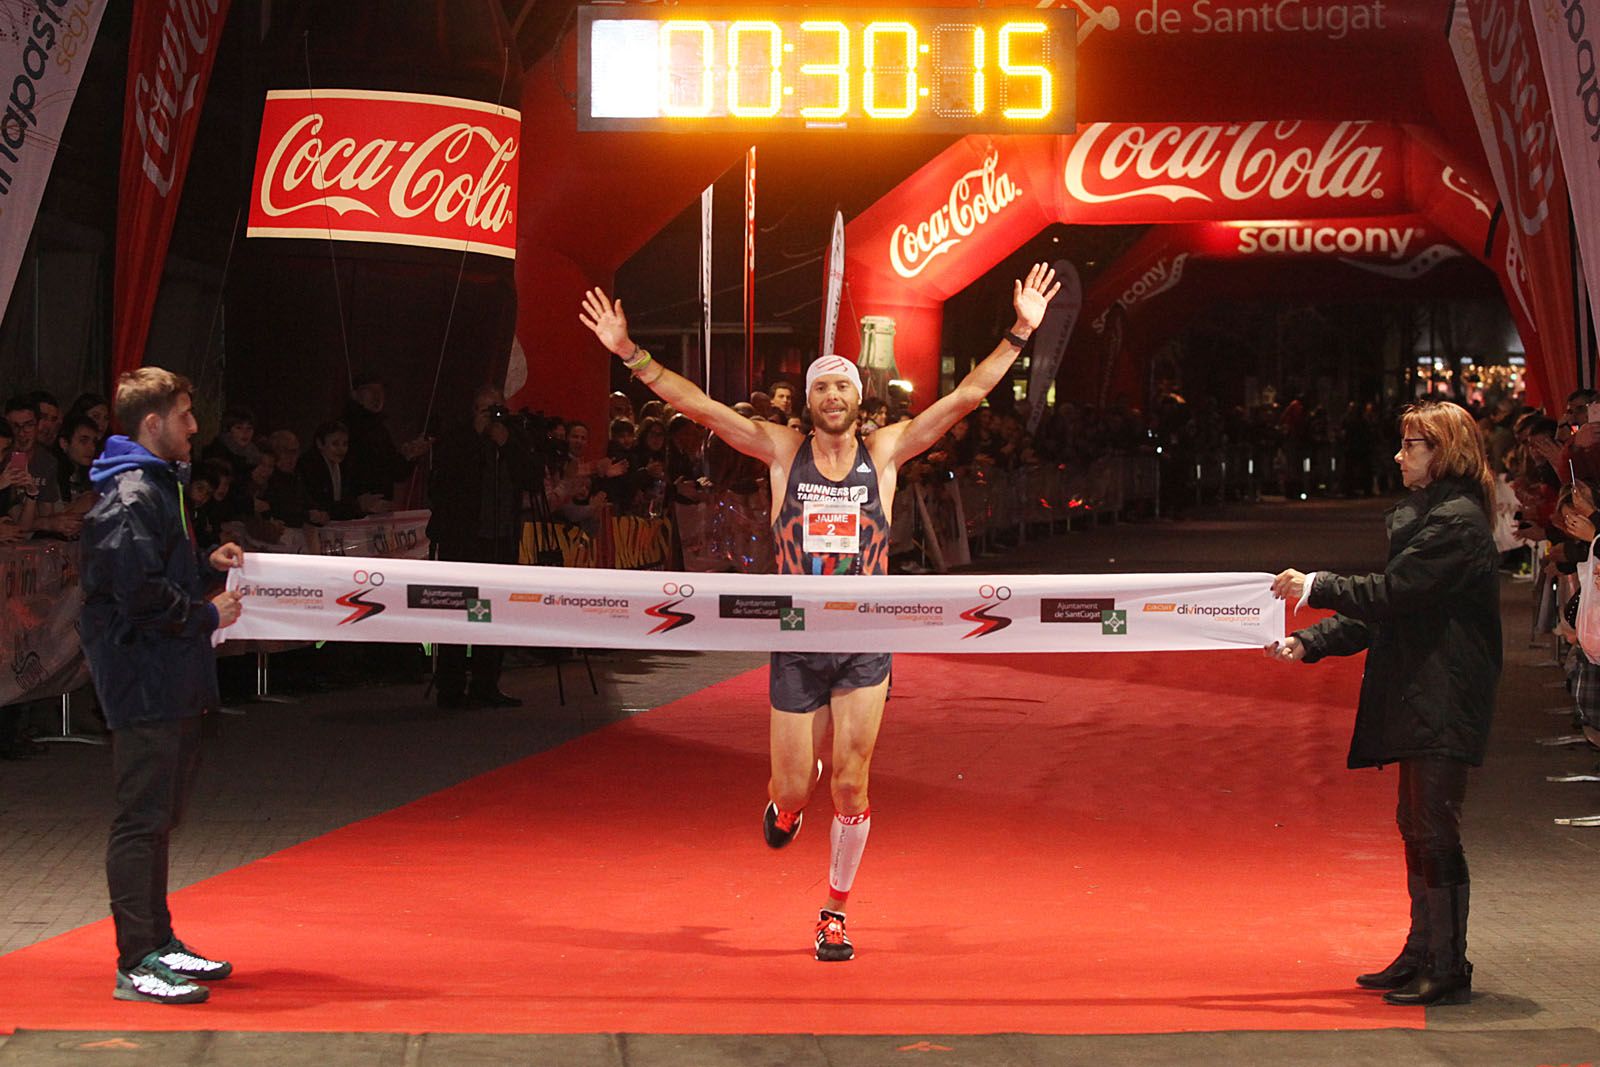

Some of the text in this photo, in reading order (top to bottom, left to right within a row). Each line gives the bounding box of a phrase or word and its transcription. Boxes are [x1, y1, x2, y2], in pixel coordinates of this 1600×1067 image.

[1134, 0, 1387, 40] de SantCugat
[659, 20, 1053, 119] 00:30:15
[1063, 120, 1383, 204] Coca-Cola
[260, 112, 514, 233] Coca-Cola
[889, 150, 1018, 279] Coca-Cola
[1237, 225, 1414, 257] saucony
[797, 483, 849, 496] RUNNERS
[815, 514, 849, 523] JAUME
[826, 524, 836, 536] 2
[543, 594, 629, 608] divinapastora
[1057, 602, 1098, 611] Ajuntament
[858, 602, 943, 616] divinapastora
[1065, 610, 1100, 620] SantCugat
[1177, 603, 1260, 617] divinapastora
